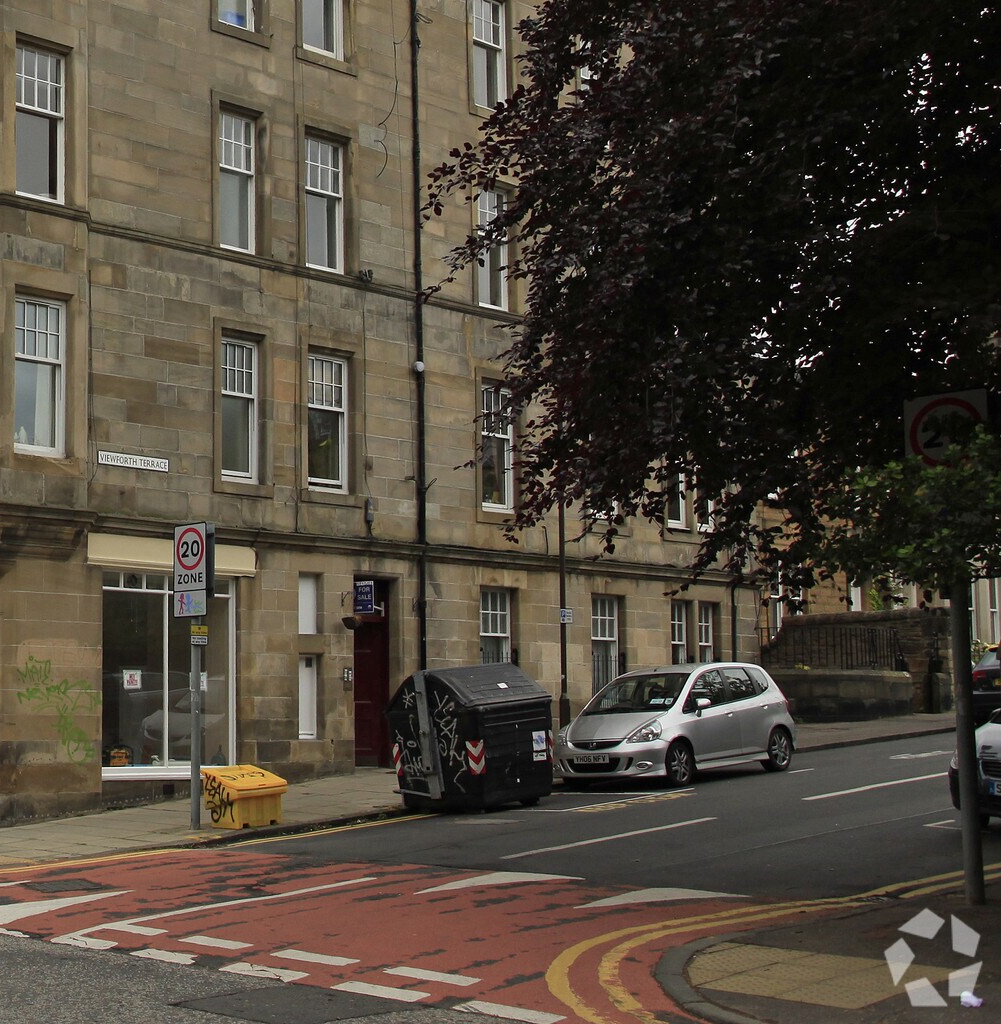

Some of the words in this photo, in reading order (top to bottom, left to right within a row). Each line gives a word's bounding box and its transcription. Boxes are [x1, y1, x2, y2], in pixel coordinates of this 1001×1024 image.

[100, 453, 138, 466] VIEWFORTH
[139, 458, 168, 470] TERRACE
[181, 540, 200, 558] 20
[177, 572, 203, 584] ZONE
